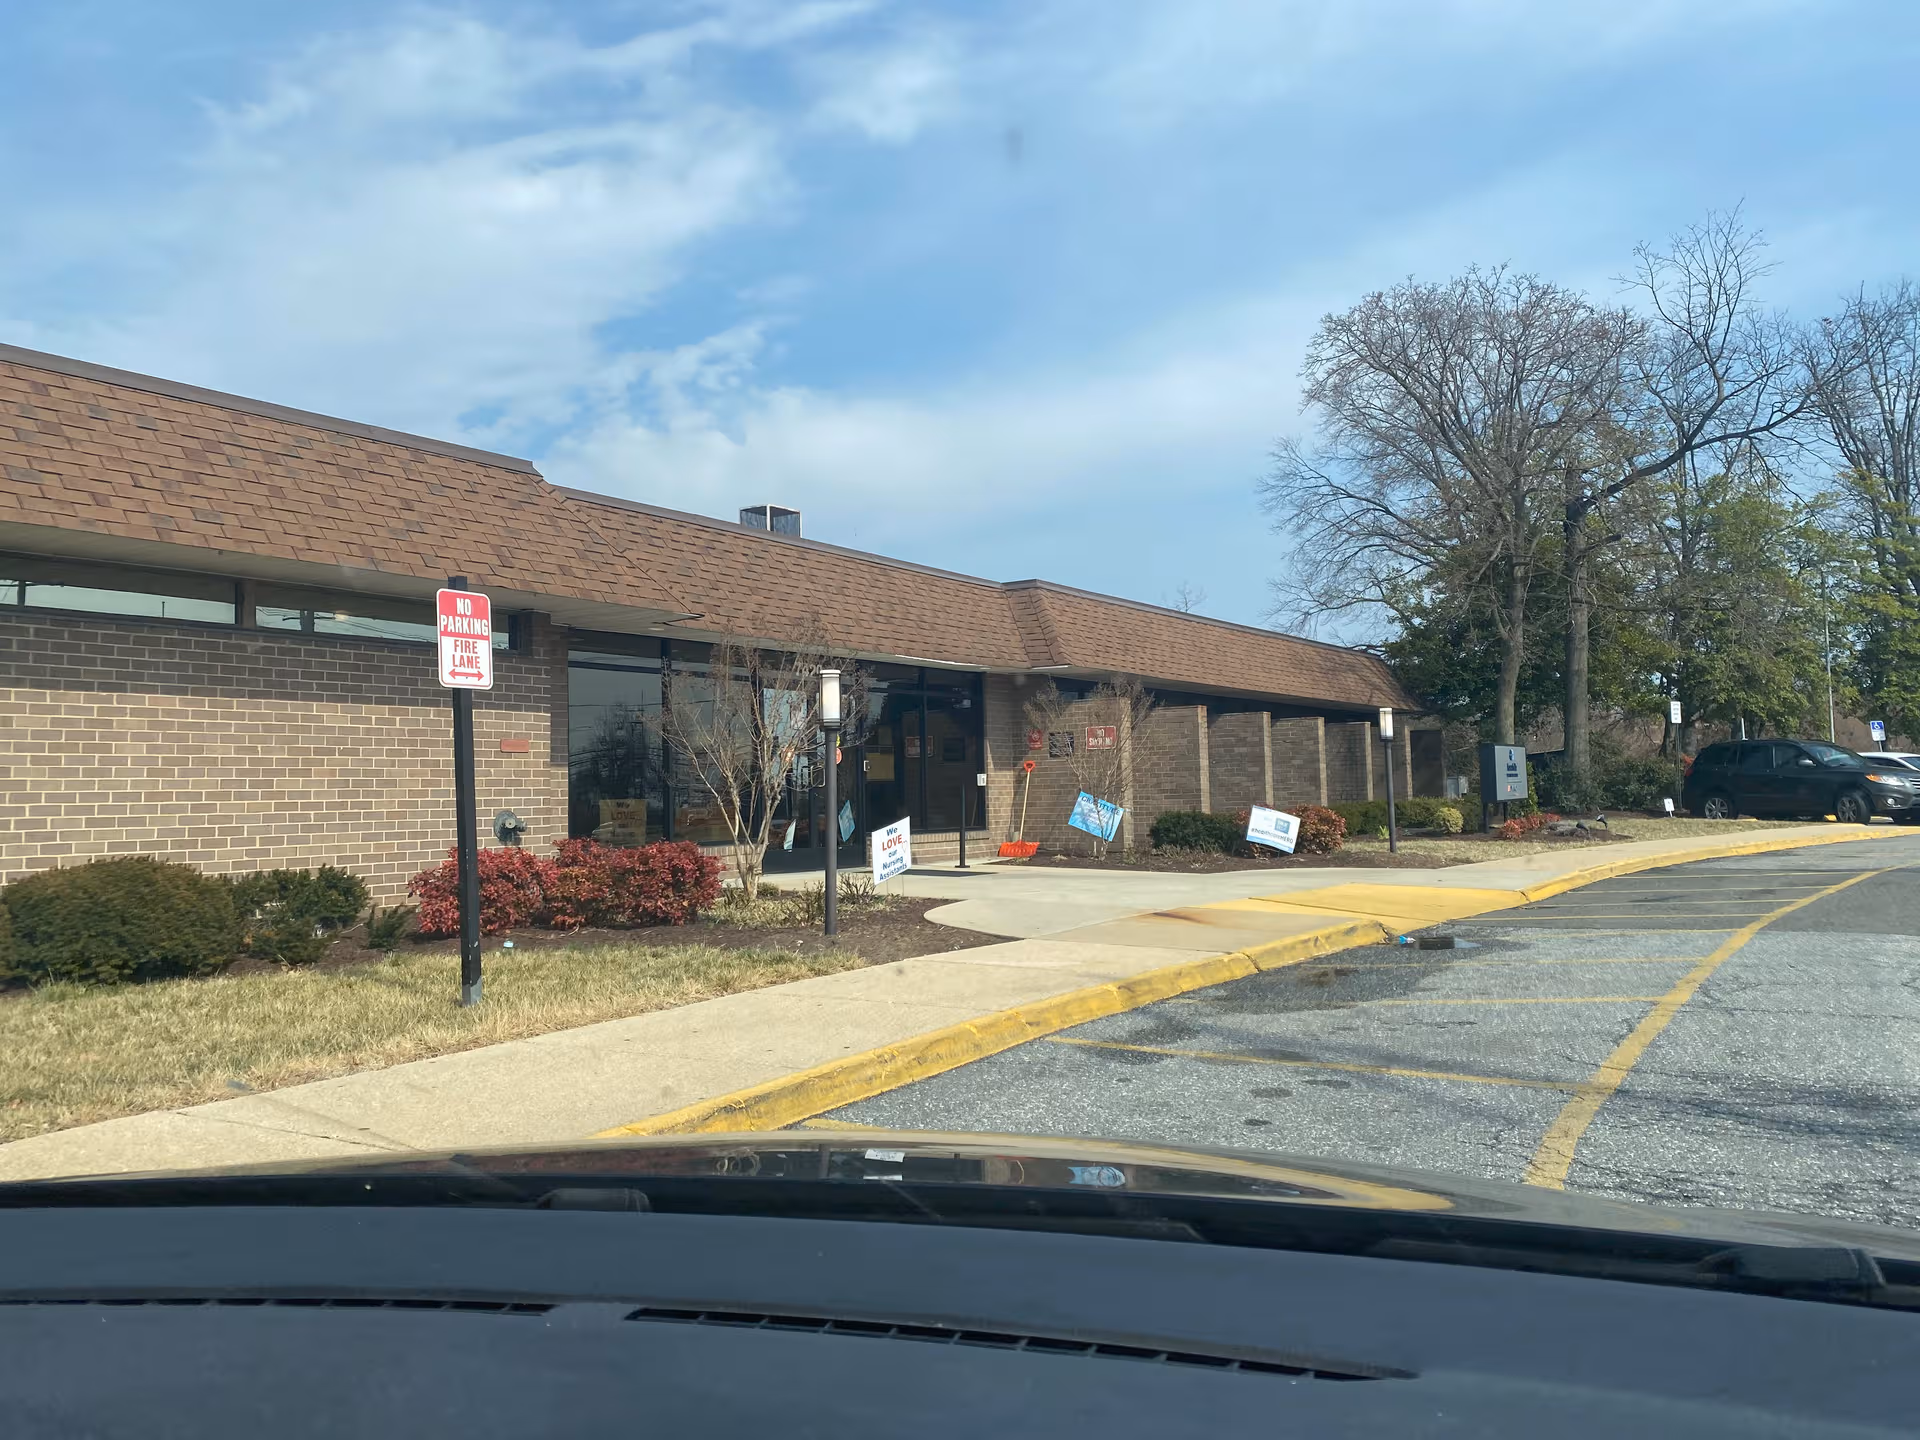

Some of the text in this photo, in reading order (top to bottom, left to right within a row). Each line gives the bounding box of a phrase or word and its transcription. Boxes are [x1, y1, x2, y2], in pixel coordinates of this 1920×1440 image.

[456, 597, 472, 616] NO
[440, 614, 489, 636] PARKING
[453, 639, 478, 654] FIRE
[452, 654, 481, 669] LANE
[1081, 796, 1120, 815] GRITUDE
[886, 827, 898, 836] We
[882, 834, 902, 851] LOVE
[879, 863, 907, 880] Assistants
[882, 856, 904, 870] Nursing
